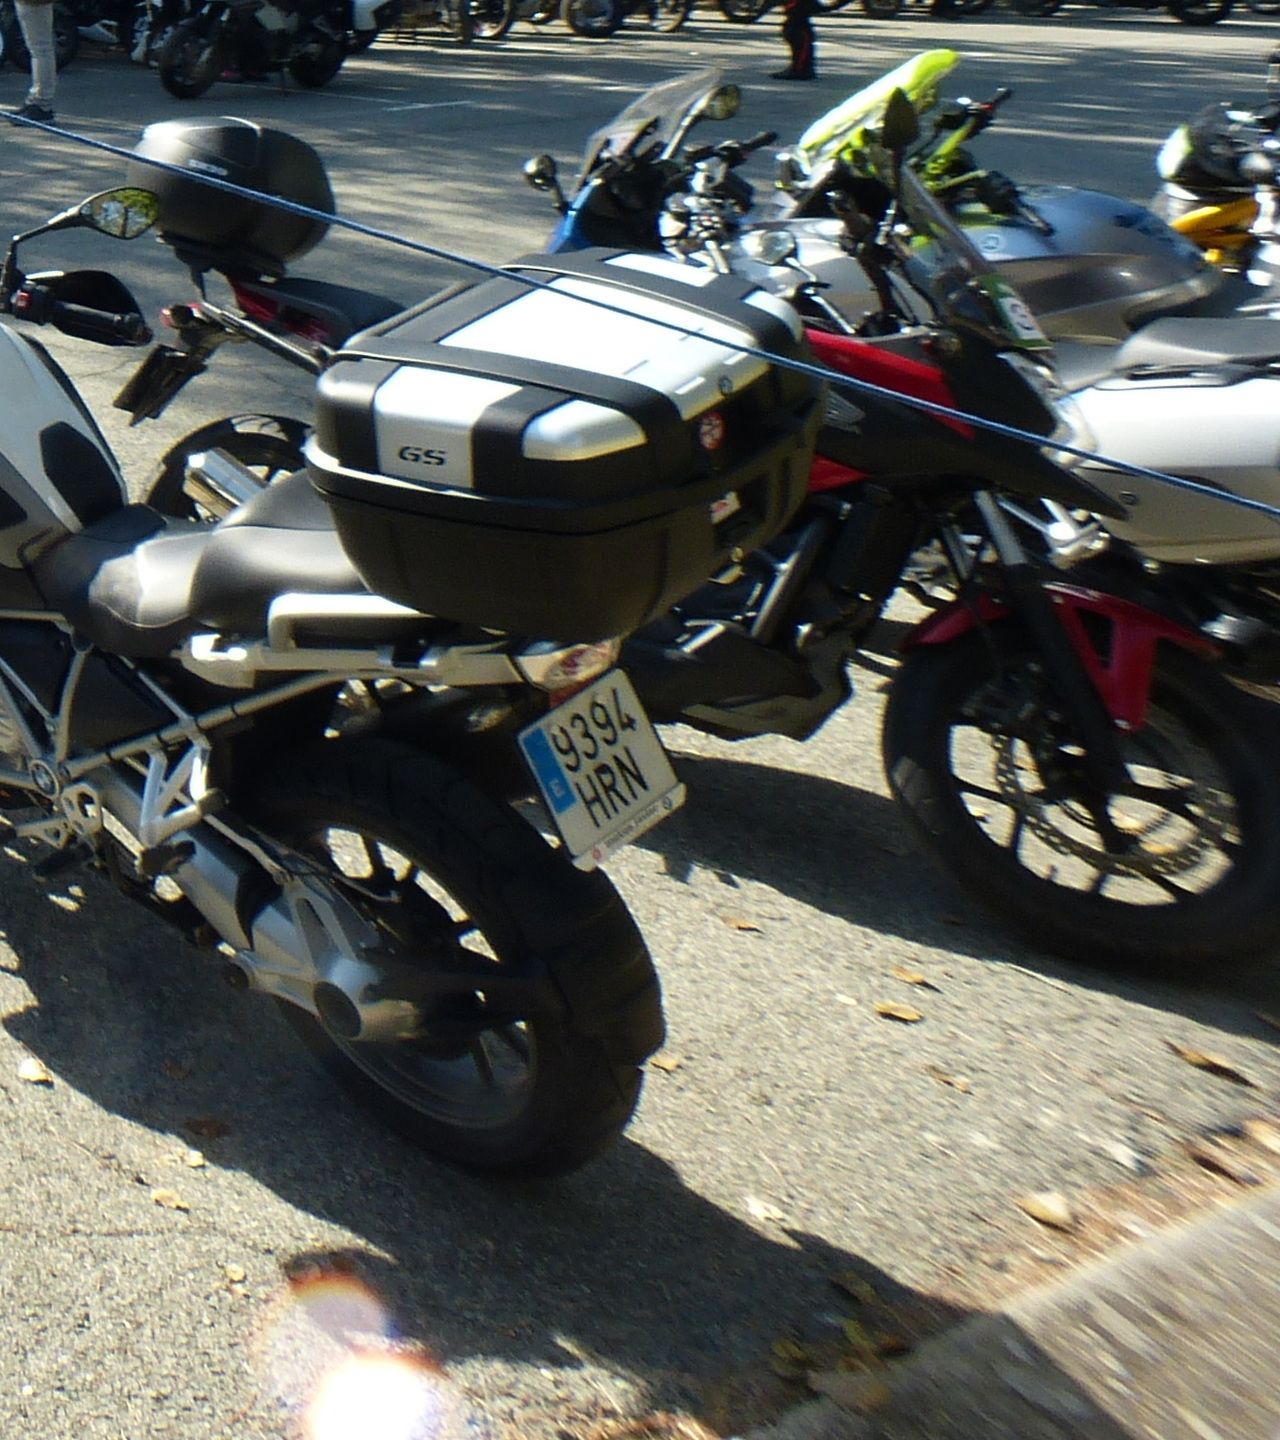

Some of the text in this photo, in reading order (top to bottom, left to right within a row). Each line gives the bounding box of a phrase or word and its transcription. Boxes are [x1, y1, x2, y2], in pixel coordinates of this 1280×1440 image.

[397, 445, 448, 468] GS
[550, 687, 638, 773] 9394
[574, 744, 650, 828] HRN
